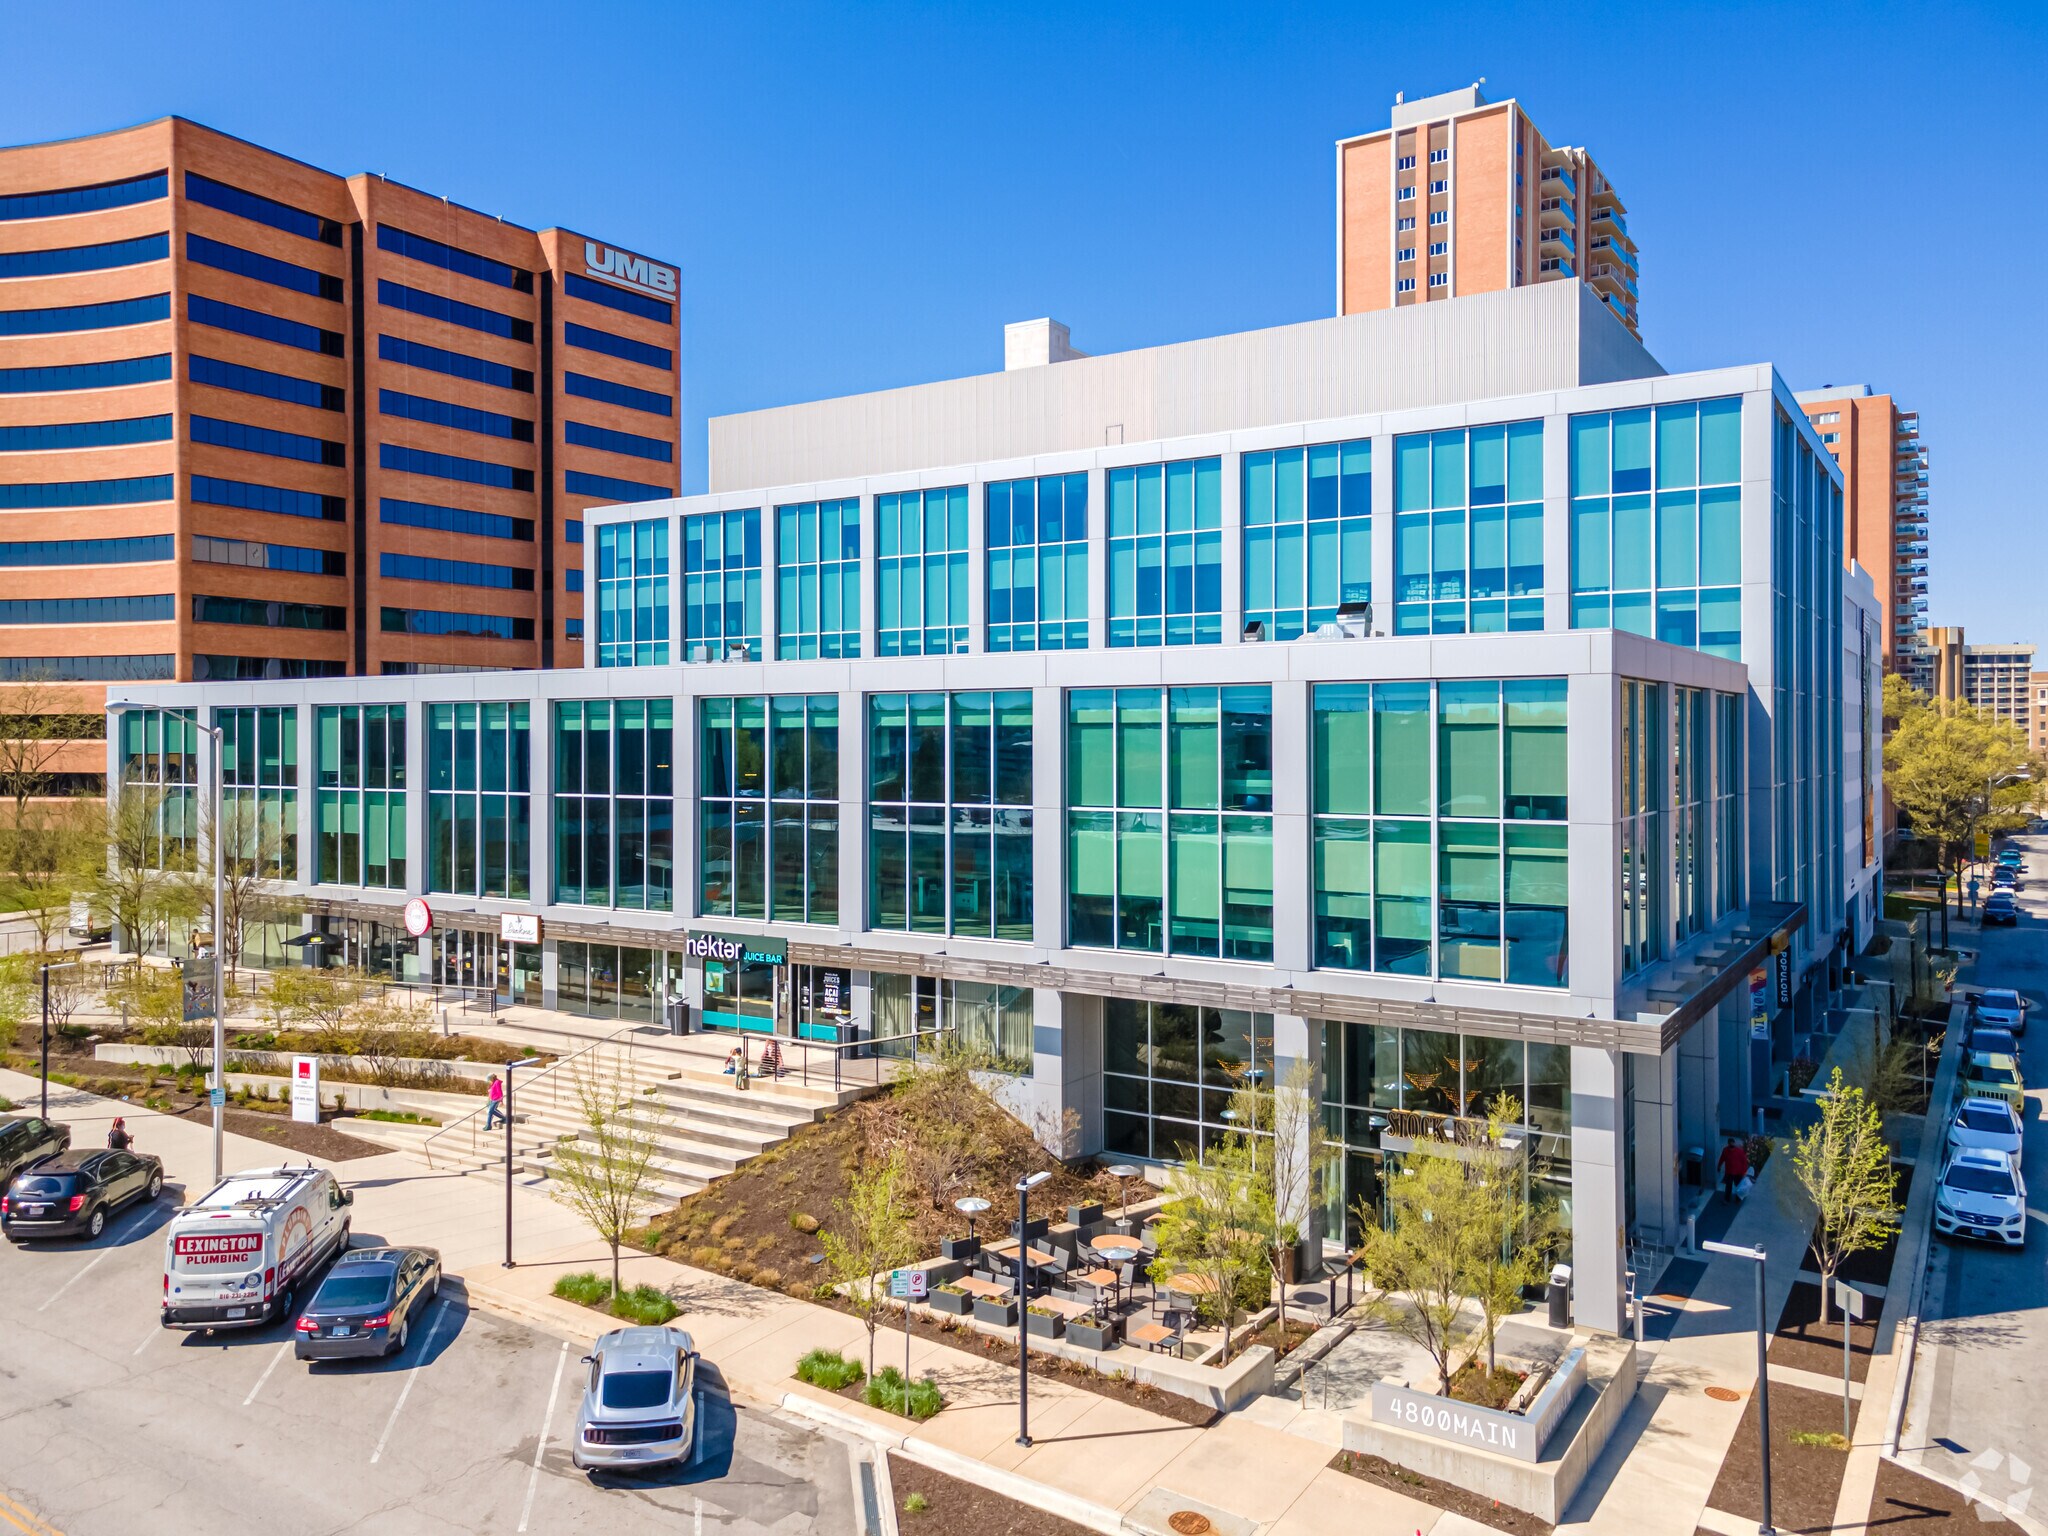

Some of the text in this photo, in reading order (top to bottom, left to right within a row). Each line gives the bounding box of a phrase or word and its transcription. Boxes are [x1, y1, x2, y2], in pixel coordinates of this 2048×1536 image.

[585, 241, 676, 292] UMB
[743, 951, 782, 963] JUICE BAR
[1780, 951, 1789, 1003] POPULOUS
[1386, 1111, 1449, 1143] STOCK
[179, 1237, 257, 1252] LEXINGTON
[186, 1254, 248, 1264] PLUMBING
[1390, 1398, 1516, 1449] 4800MAIN
